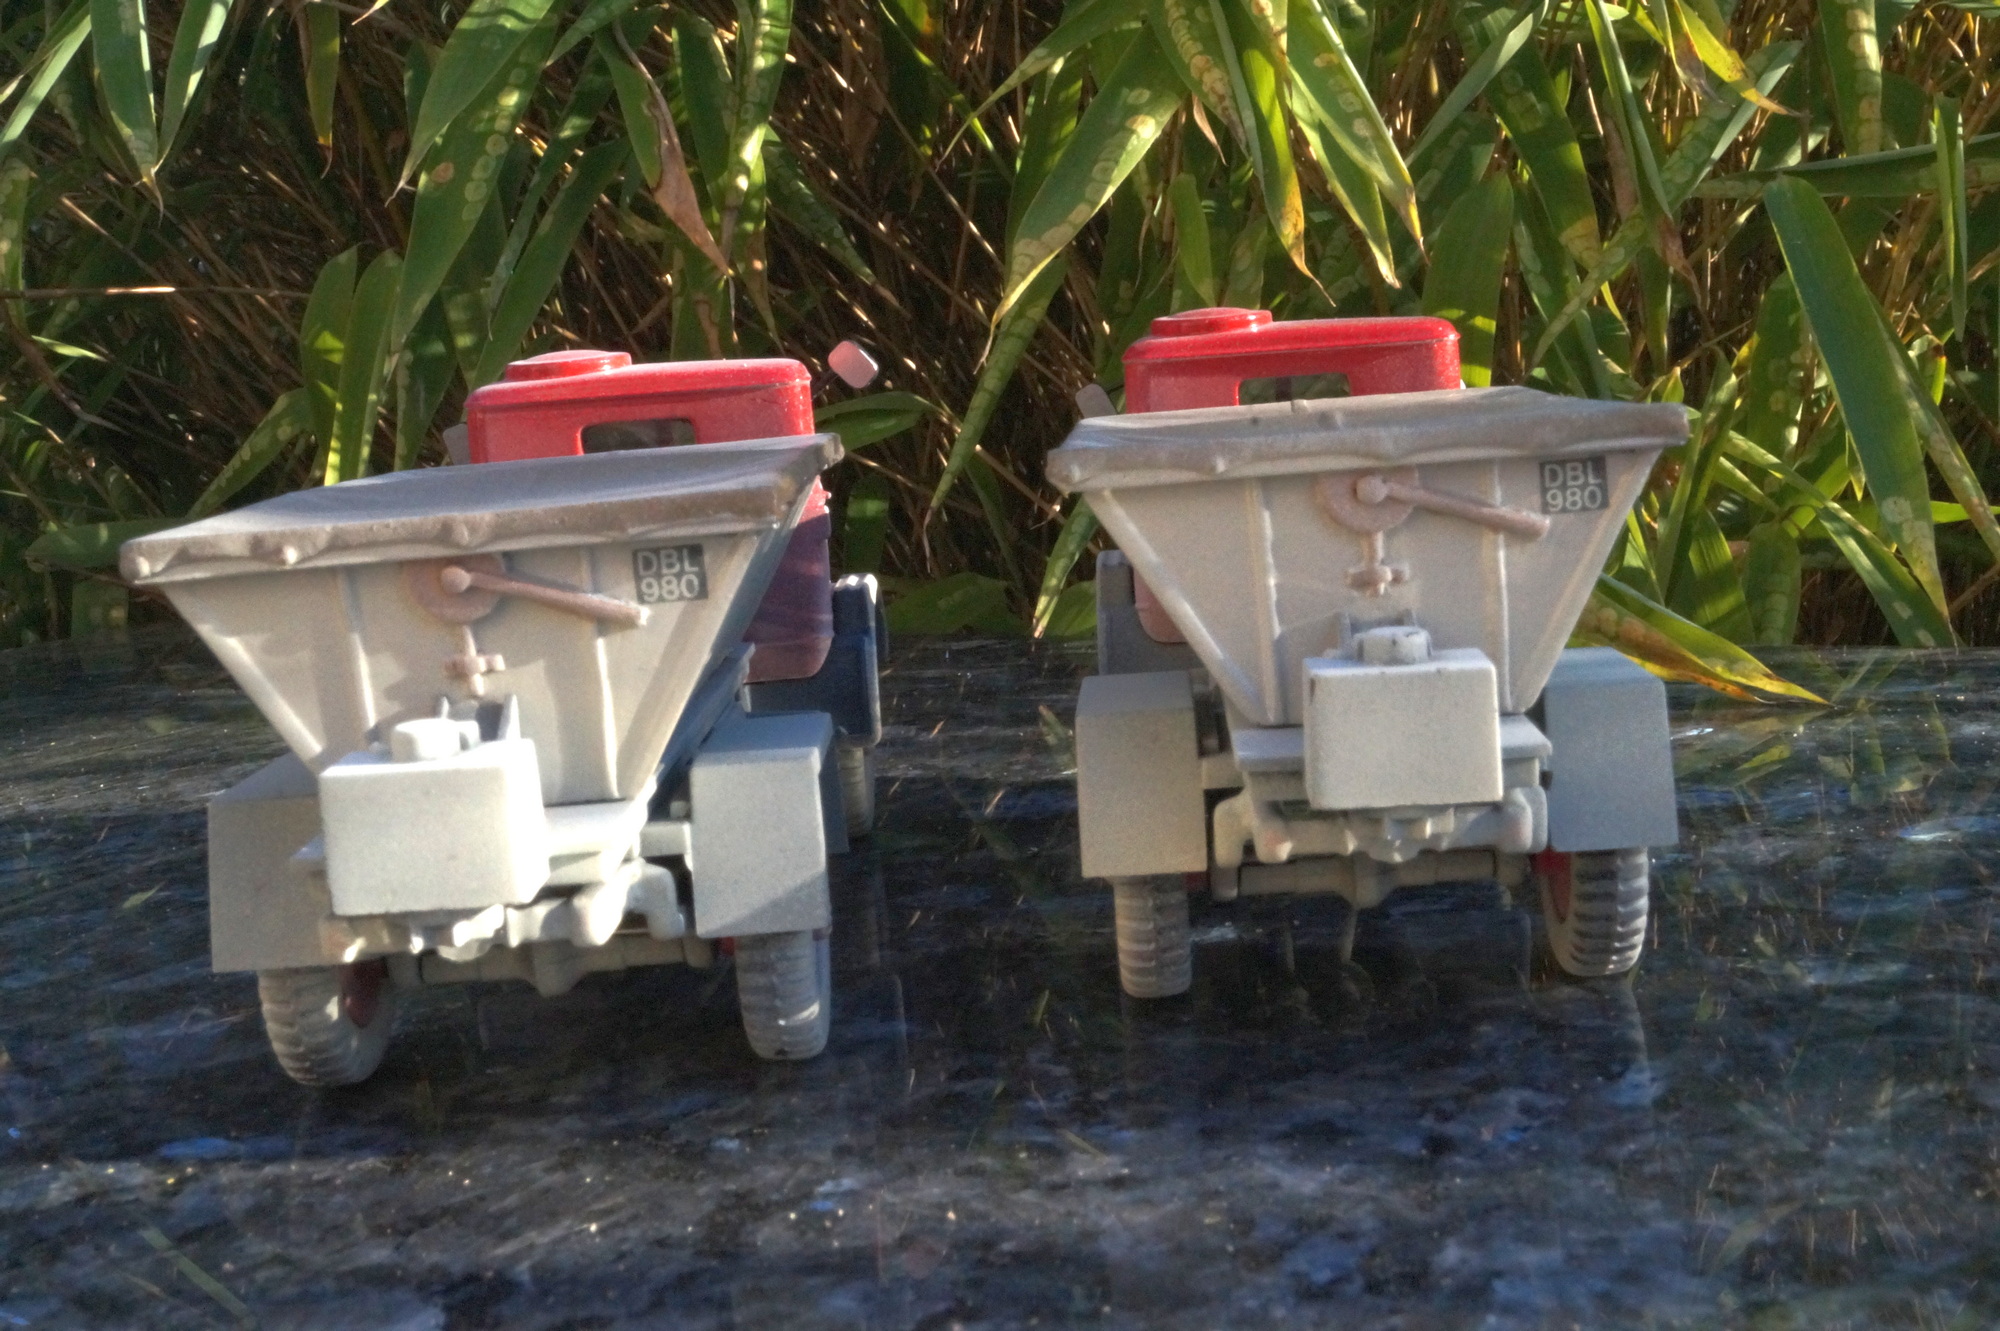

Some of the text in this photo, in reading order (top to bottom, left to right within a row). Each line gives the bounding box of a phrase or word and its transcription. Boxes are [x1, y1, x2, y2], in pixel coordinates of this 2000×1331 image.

[1544, 460, 1601, 487] DBL
[1546, 486, 1602, 511] 980
[637, 548, 699, 576] DBL
[640, 573, 699, 602] 980
